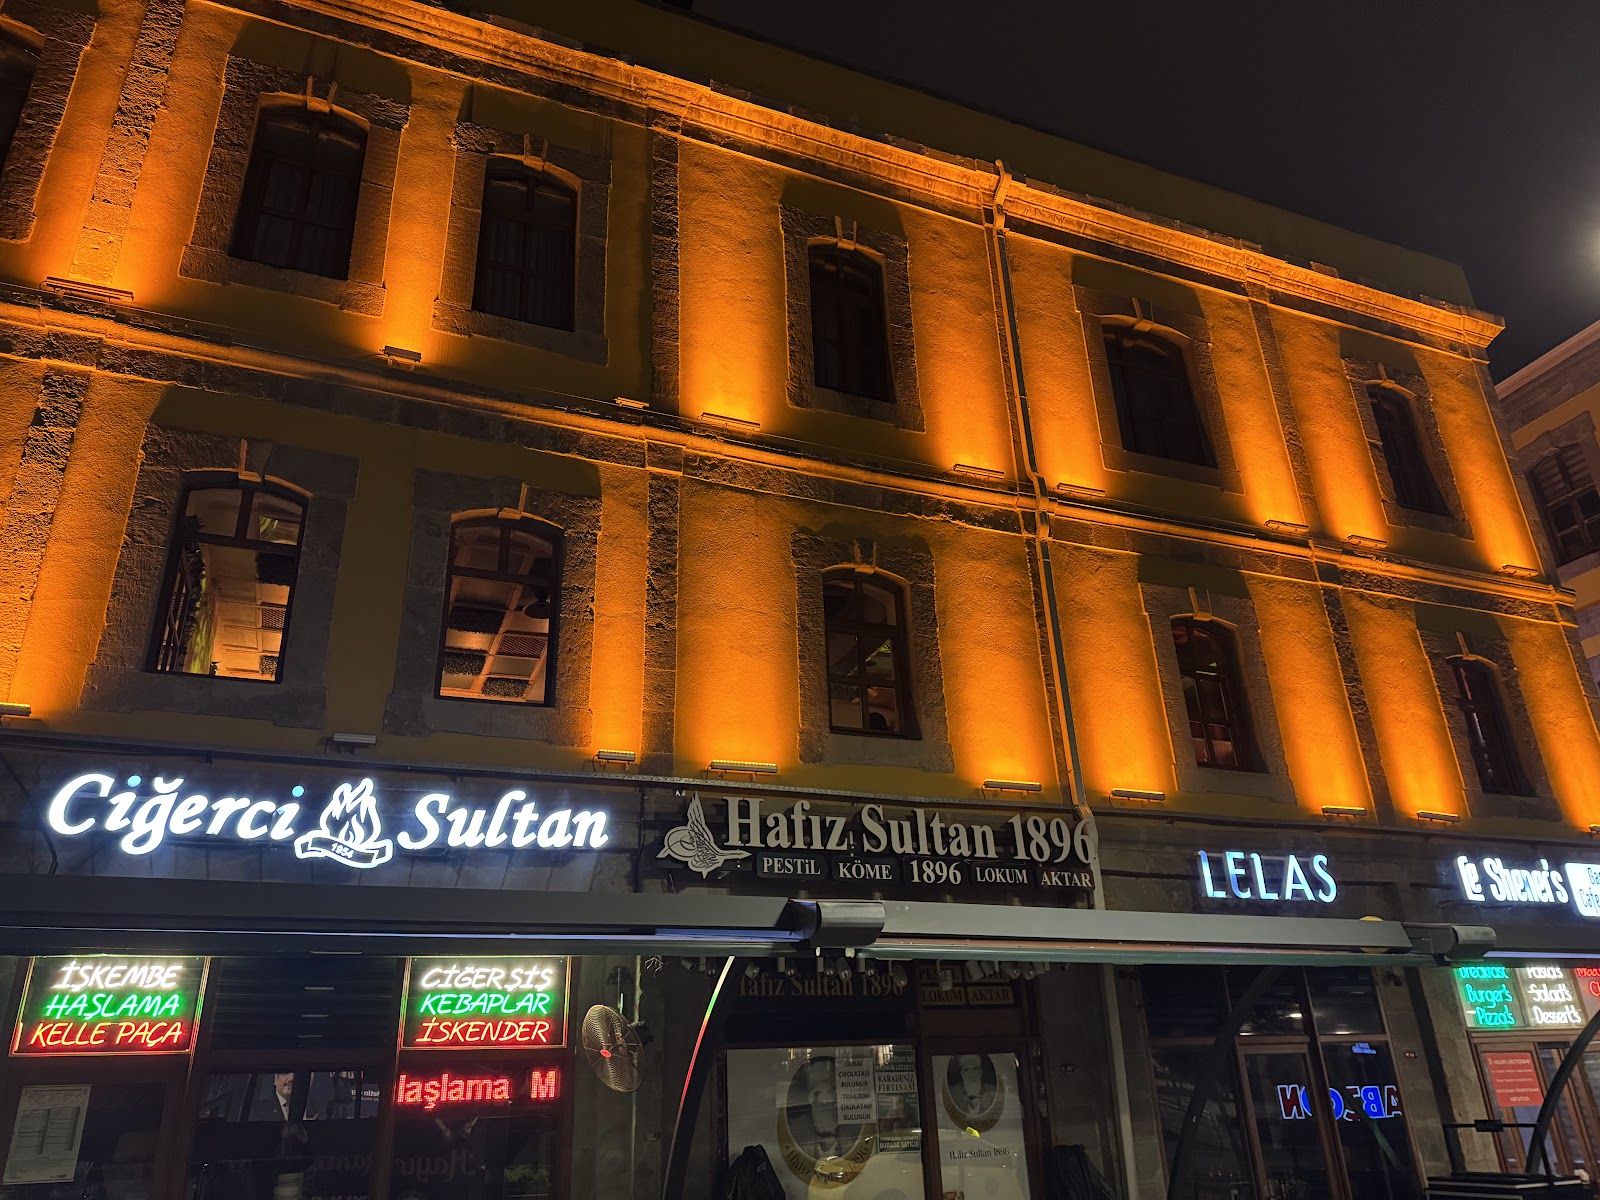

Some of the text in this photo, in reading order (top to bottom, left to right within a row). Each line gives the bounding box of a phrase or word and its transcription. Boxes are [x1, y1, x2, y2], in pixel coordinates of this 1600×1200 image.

[48, 773, 609, 854] Ciğerci Sultan
[723, 797, 1096, 865] Hafız Sultan 1896
[837, 859, 894, 880] KÖME
[909, 860, 963, 886] 1896
[975, 866, 1029, 885] LOKUM
[1040, 871, 1093, 888] AKTAR
[1198, 849, 1338, 903] LELAS
[53, 960, 183, 992] İŞKEMBE
[421, 964, 554, 992] CİĞER ŞİŞ
[45, 993, 181, 1020] HAŞLAMA
[420, 993, 551, 1015] KEBAPLAR
[971, 988, 1011, 1003] AKTAR
[29, 1021, 183, 1047] KELLE PAÇA
[416, 1017, 550, 1043] İSKENDER
[530, 1070, 556, 1099] M
[840, 1080, 869, 1088] BULUNUR
[877, 1073, 915, 1083] KARADENİZ
[878, 1083, 915, 1092] FIRTINASI
[843, 1113, 871, 1121] BULUNUR
